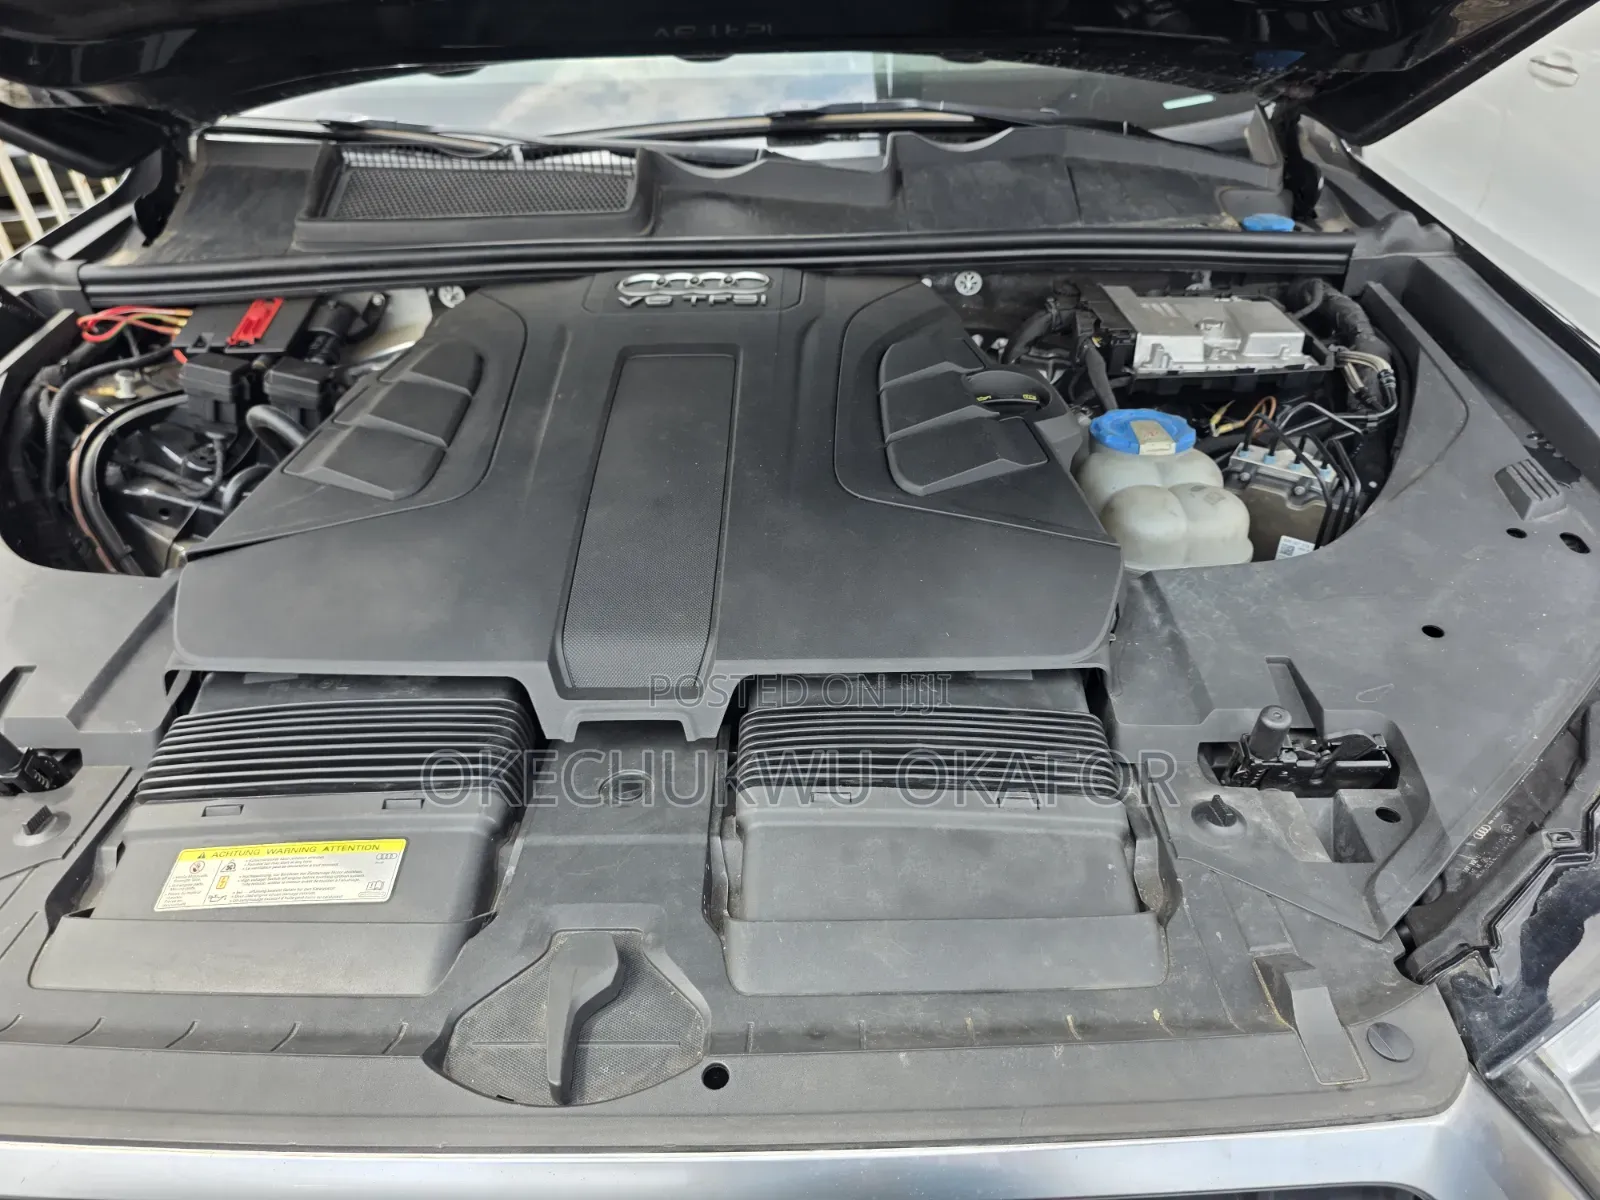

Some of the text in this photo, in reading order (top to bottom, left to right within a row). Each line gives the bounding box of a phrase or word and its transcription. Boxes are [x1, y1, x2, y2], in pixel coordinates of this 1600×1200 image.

[682, 294, 767, 307] TFSI
[211, 848, 260, 858] ACHTUNG
[266, 846, 317, 855] WARNING
[322, 844, 381, 852] ATTENTION
